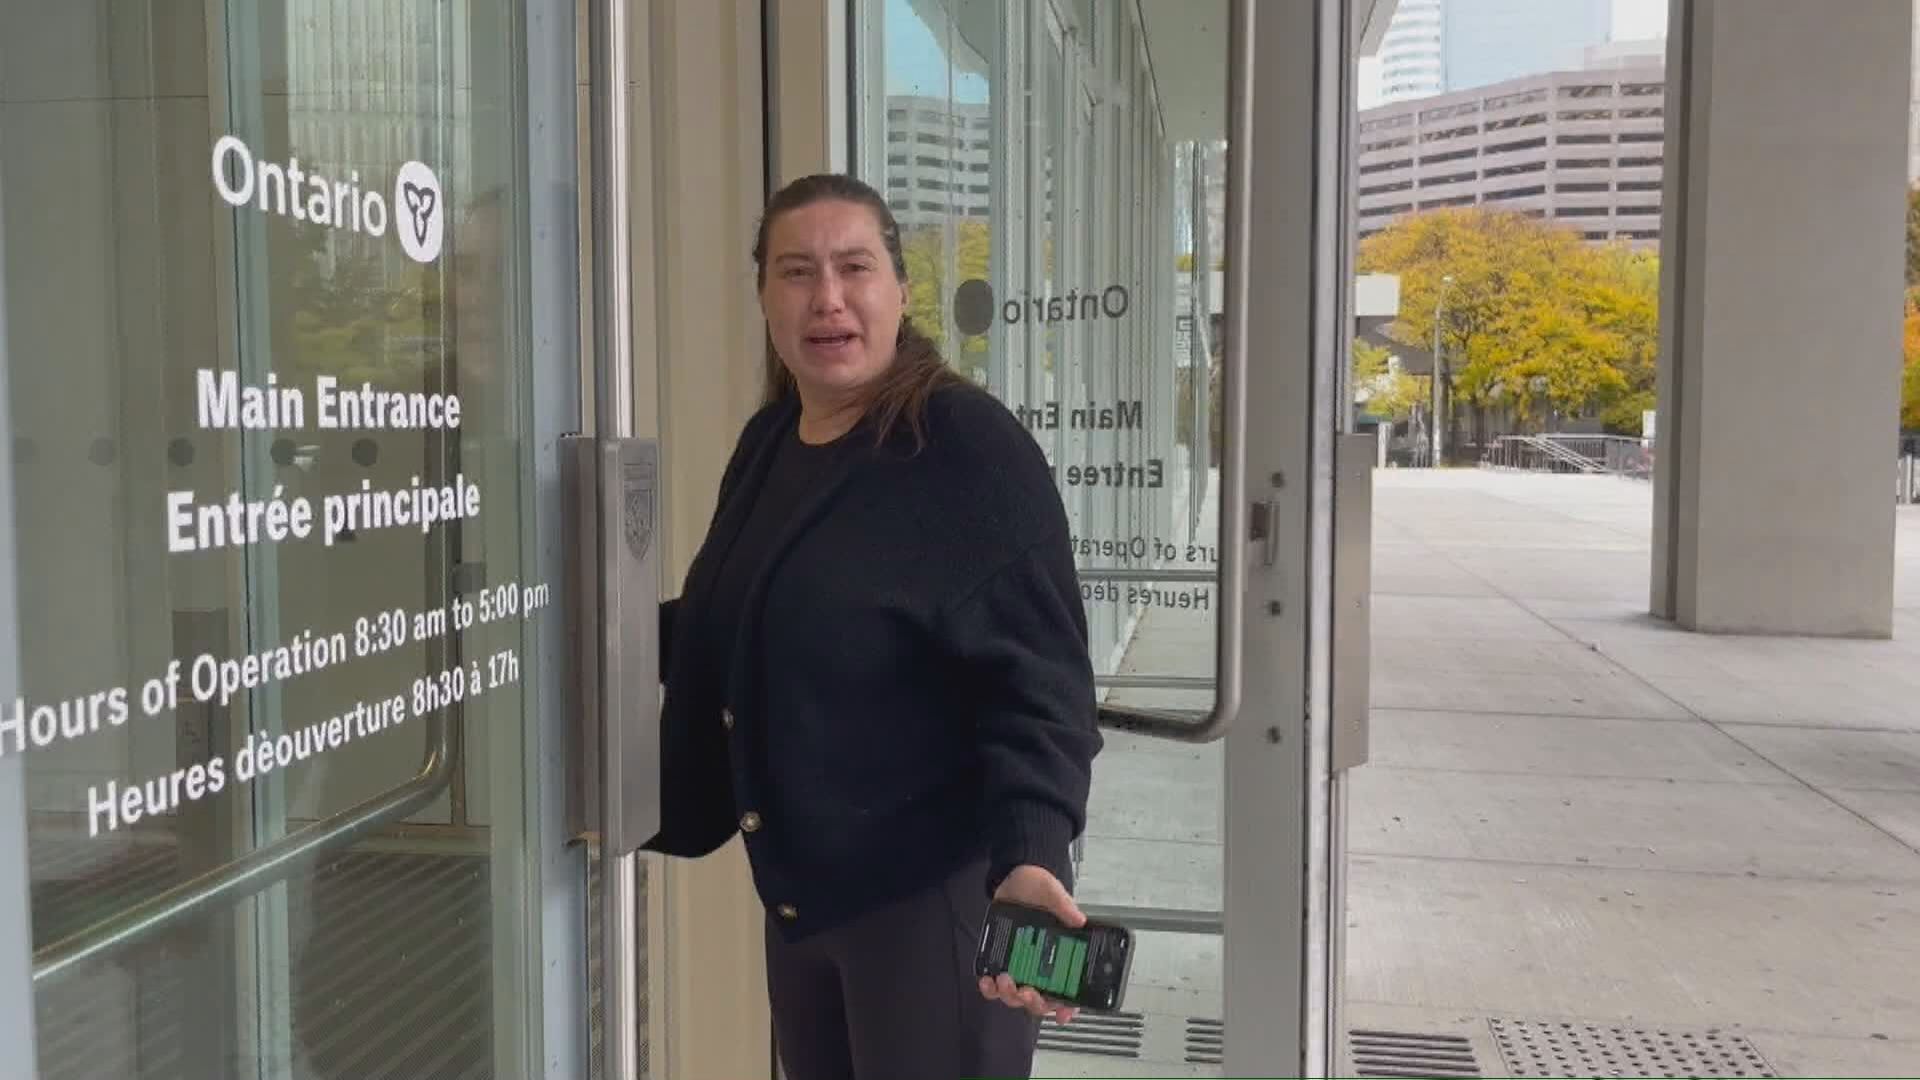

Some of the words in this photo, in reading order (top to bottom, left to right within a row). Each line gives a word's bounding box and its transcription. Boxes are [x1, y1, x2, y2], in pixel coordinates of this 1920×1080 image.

[212, 135, 387, 238] Ontario
[197, 368, 304, 429] Main
[316, 375, 461, 429] Entrance
[167, 484, 312, 553] Entrée
[324, 473, 480, 546] principale
[0, 686, 129, 757] Hours
[142, 659, 181, 716] of
[191, 633, 346, 706] Operation
[355, 608, 406, 656] 8:30
[413, 607, 446, 641] am
[452, 597, 473, 630] to
[479, 582, 518, 623] 5:00
[523, 583, 550, 618] pm
[88, 759, 224, 838] Heures
[235, 692, 405, 779] dèouverture
[412, 667, 464, 716] 8h30
[470, 660, 482, 696] à
[488, 649, 519, 688] 17h
